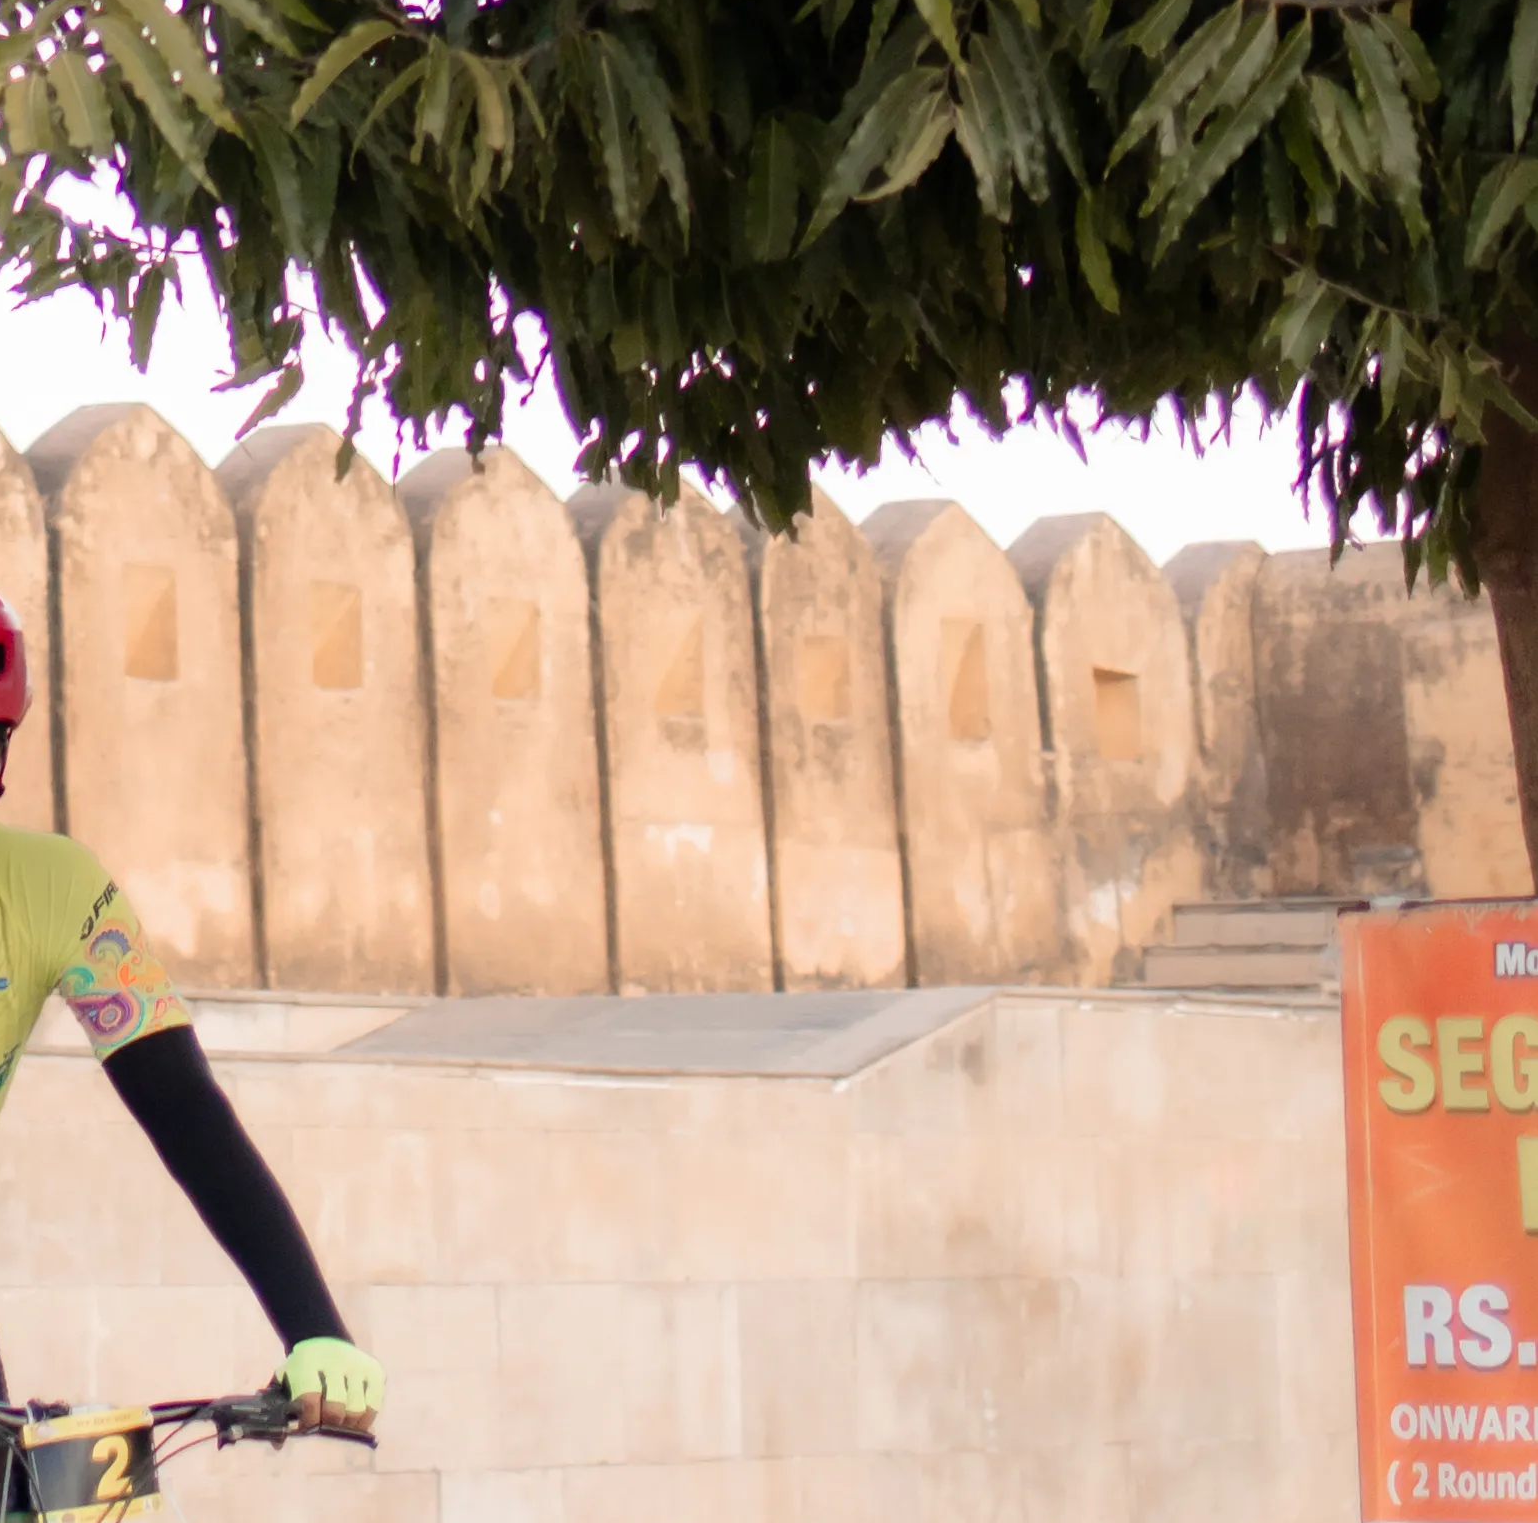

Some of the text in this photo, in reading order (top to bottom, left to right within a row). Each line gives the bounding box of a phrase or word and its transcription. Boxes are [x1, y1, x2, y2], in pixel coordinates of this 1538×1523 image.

[1495, 942, 1538, 976] Mo
[1377, 1013, 1538, 1114] SEG
[1403, 1284, 1538, 1369] RS.
[1390, 1403, 1538, 1442] ONWAR
[91, 1435, 133, 1501] 2
[1412, 1462, 1430, 1499] 2
